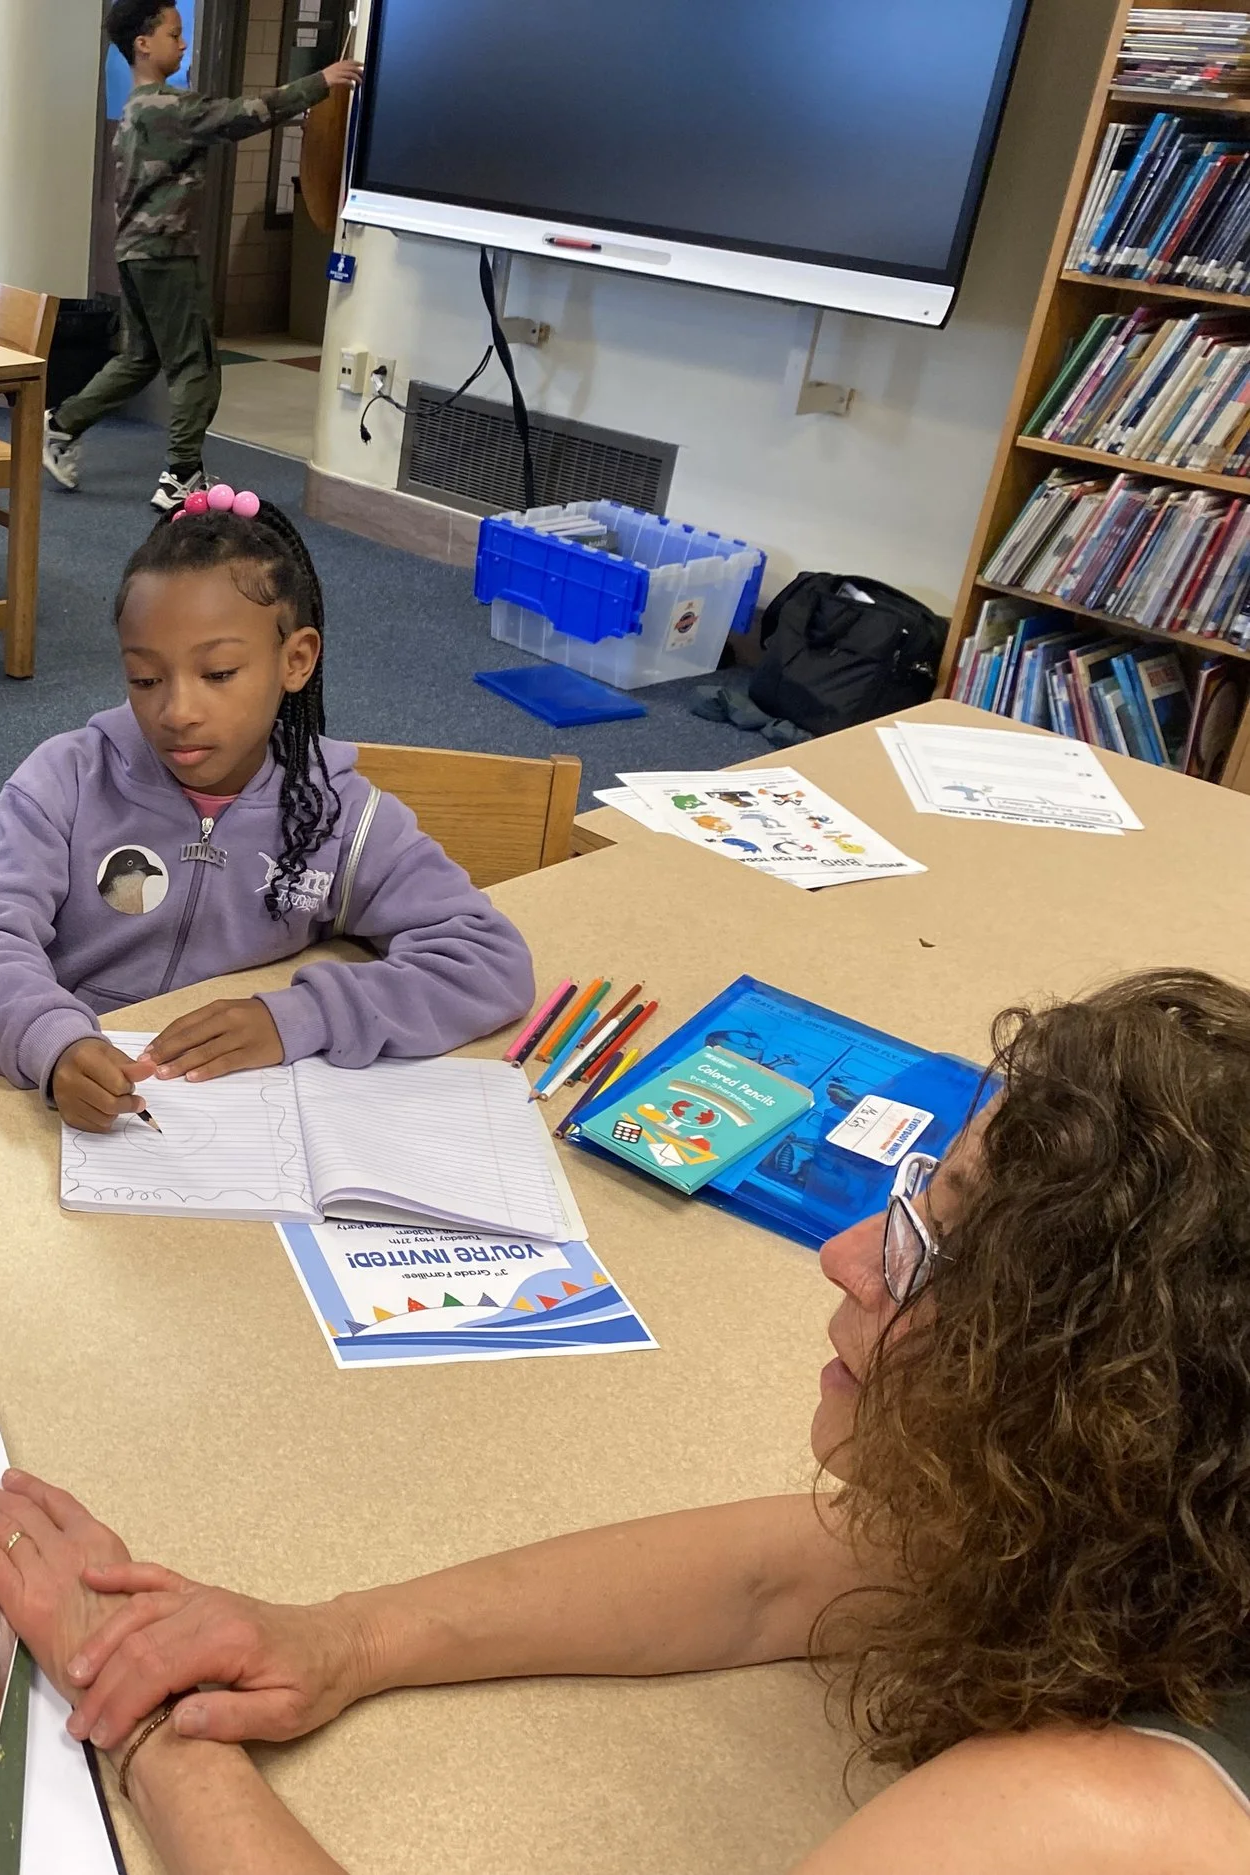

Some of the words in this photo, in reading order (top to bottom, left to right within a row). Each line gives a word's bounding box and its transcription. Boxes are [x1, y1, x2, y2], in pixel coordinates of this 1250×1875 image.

[820, 858, 862, 867] BIRD
[697, 1064, 741, 1087] Colored
[737, 1083, 776, 1107] Pencils
[337, 1223, 365, 1231] Party
[454, 1268, 491, 1278] Grade
